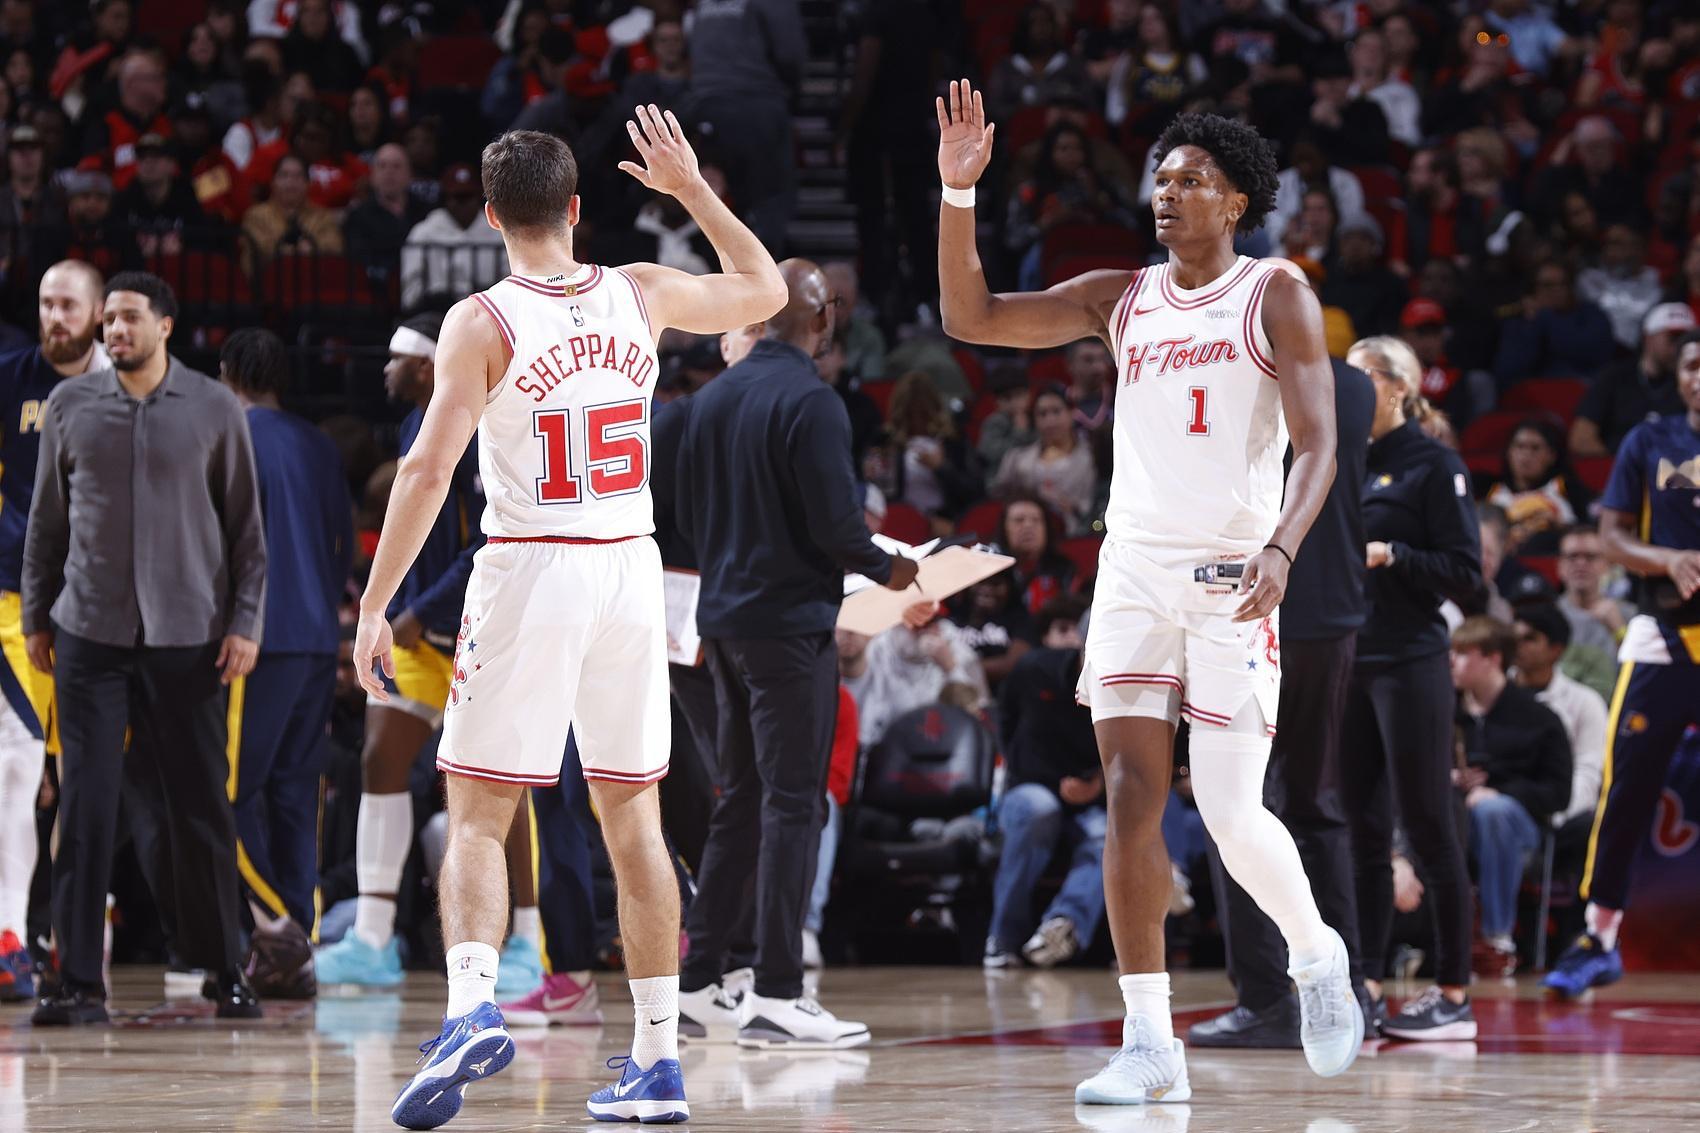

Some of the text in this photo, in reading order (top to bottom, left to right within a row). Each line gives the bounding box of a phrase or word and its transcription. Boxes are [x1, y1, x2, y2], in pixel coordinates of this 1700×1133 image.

[546, 274, 566, 284] NIKE
[515, 333, 654, 402] SHEPPARD
[1124, 334, 1239, 387] H-Town
[1186, 386, 1211, 436] 1
[533, 397, 649, 505] 15
